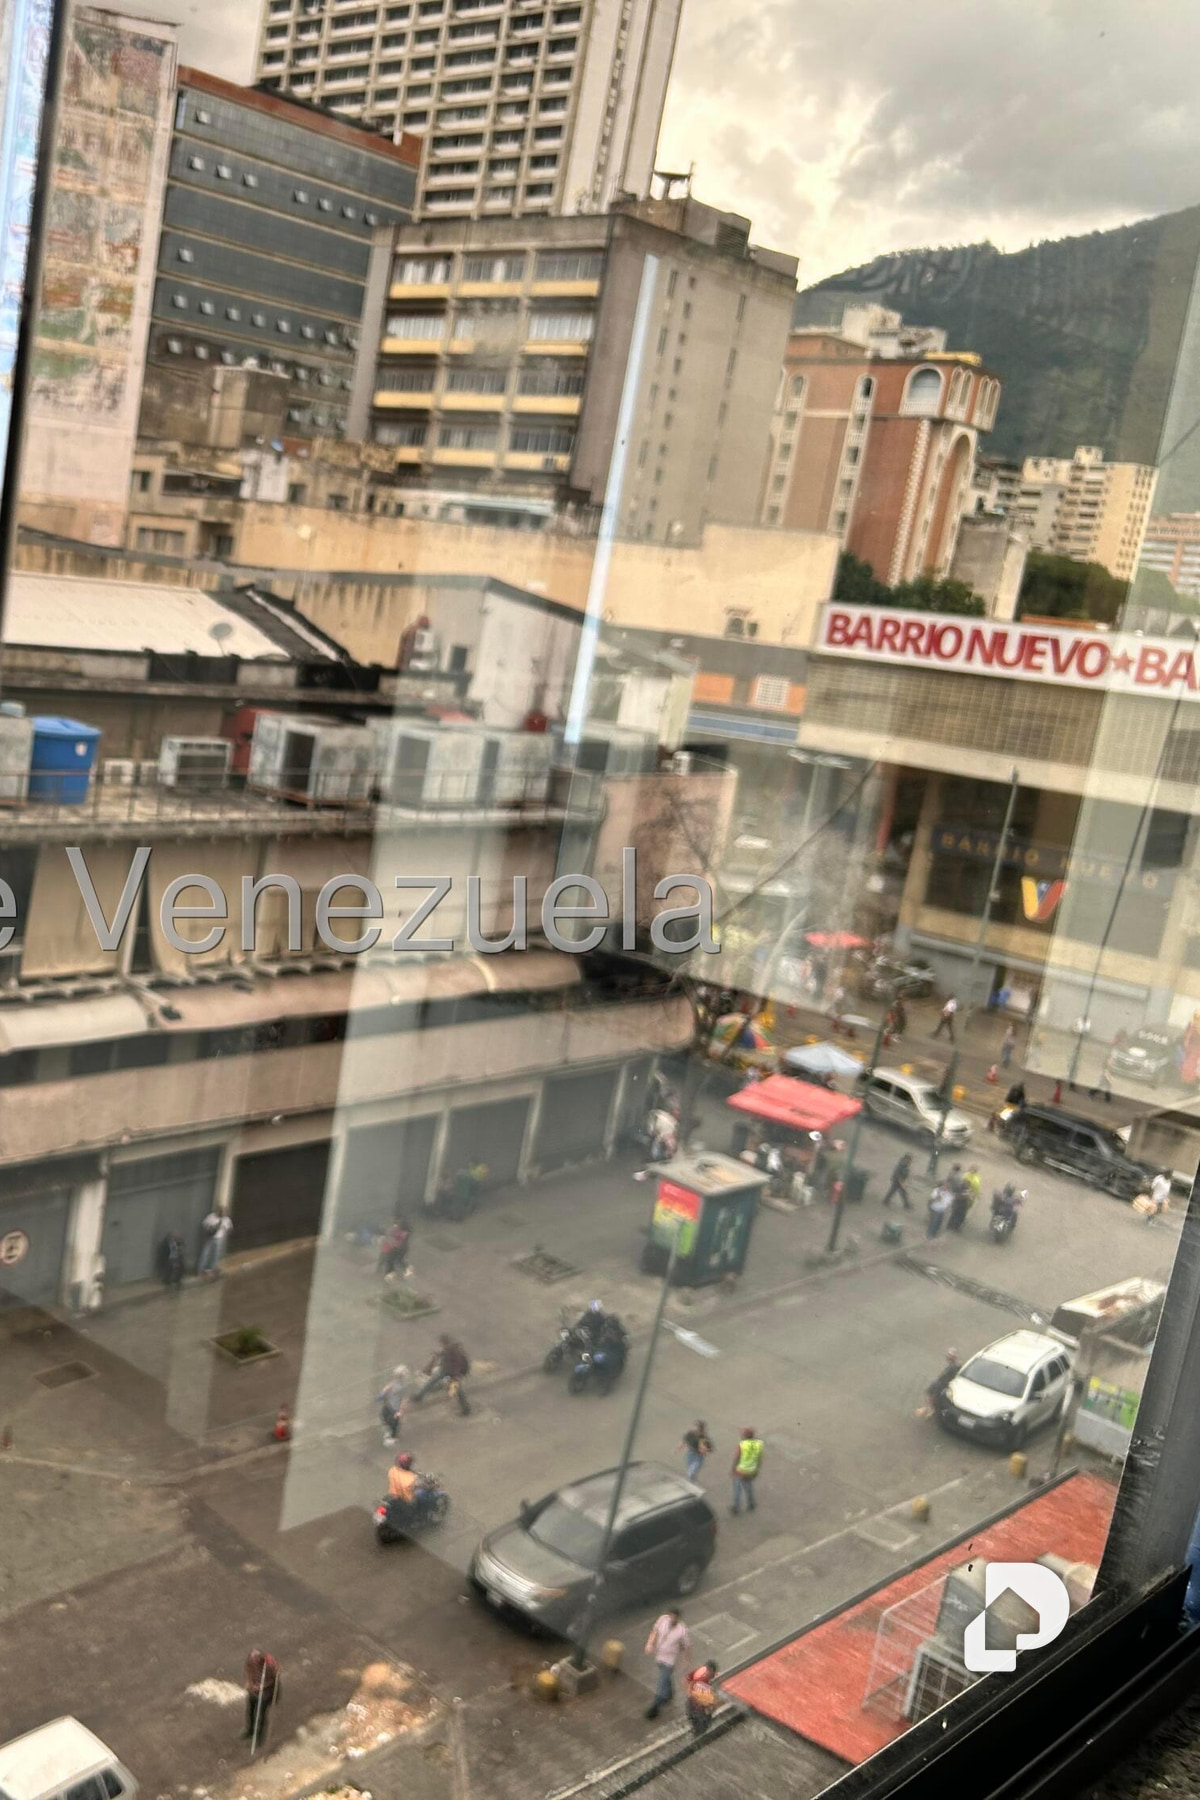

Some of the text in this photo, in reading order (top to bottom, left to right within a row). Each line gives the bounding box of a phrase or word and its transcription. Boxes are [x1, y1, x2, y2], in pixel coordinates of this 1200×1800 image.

[825, 612, 1198, 691] BARRIO NUEVO BA
